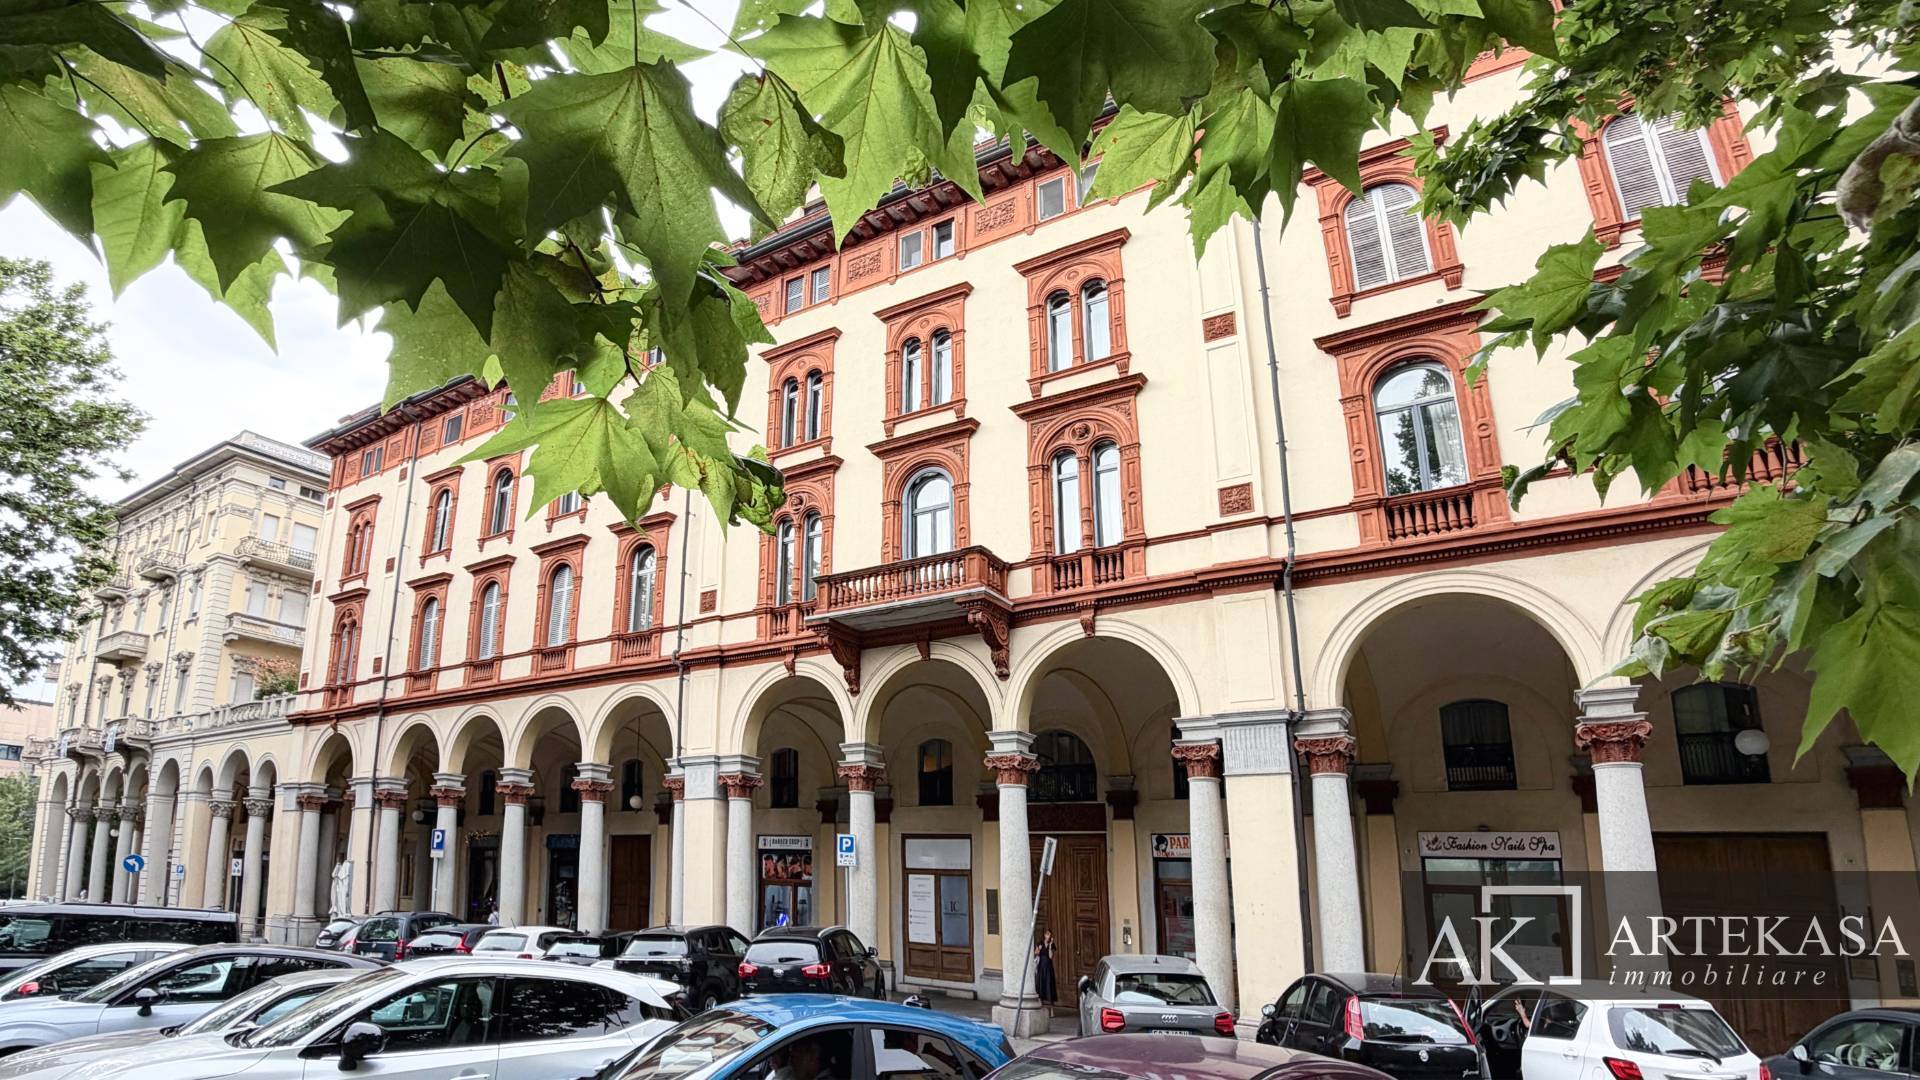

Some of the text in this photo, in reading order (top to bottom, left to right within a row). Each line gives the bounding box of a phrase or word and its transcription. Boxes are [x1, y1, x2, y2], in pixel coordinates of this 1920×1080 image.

[433, 831, 443, 849] P
[842, 838, 852, 851] P
[1443, 836, 1556, 856] Fashion Nails Spa
